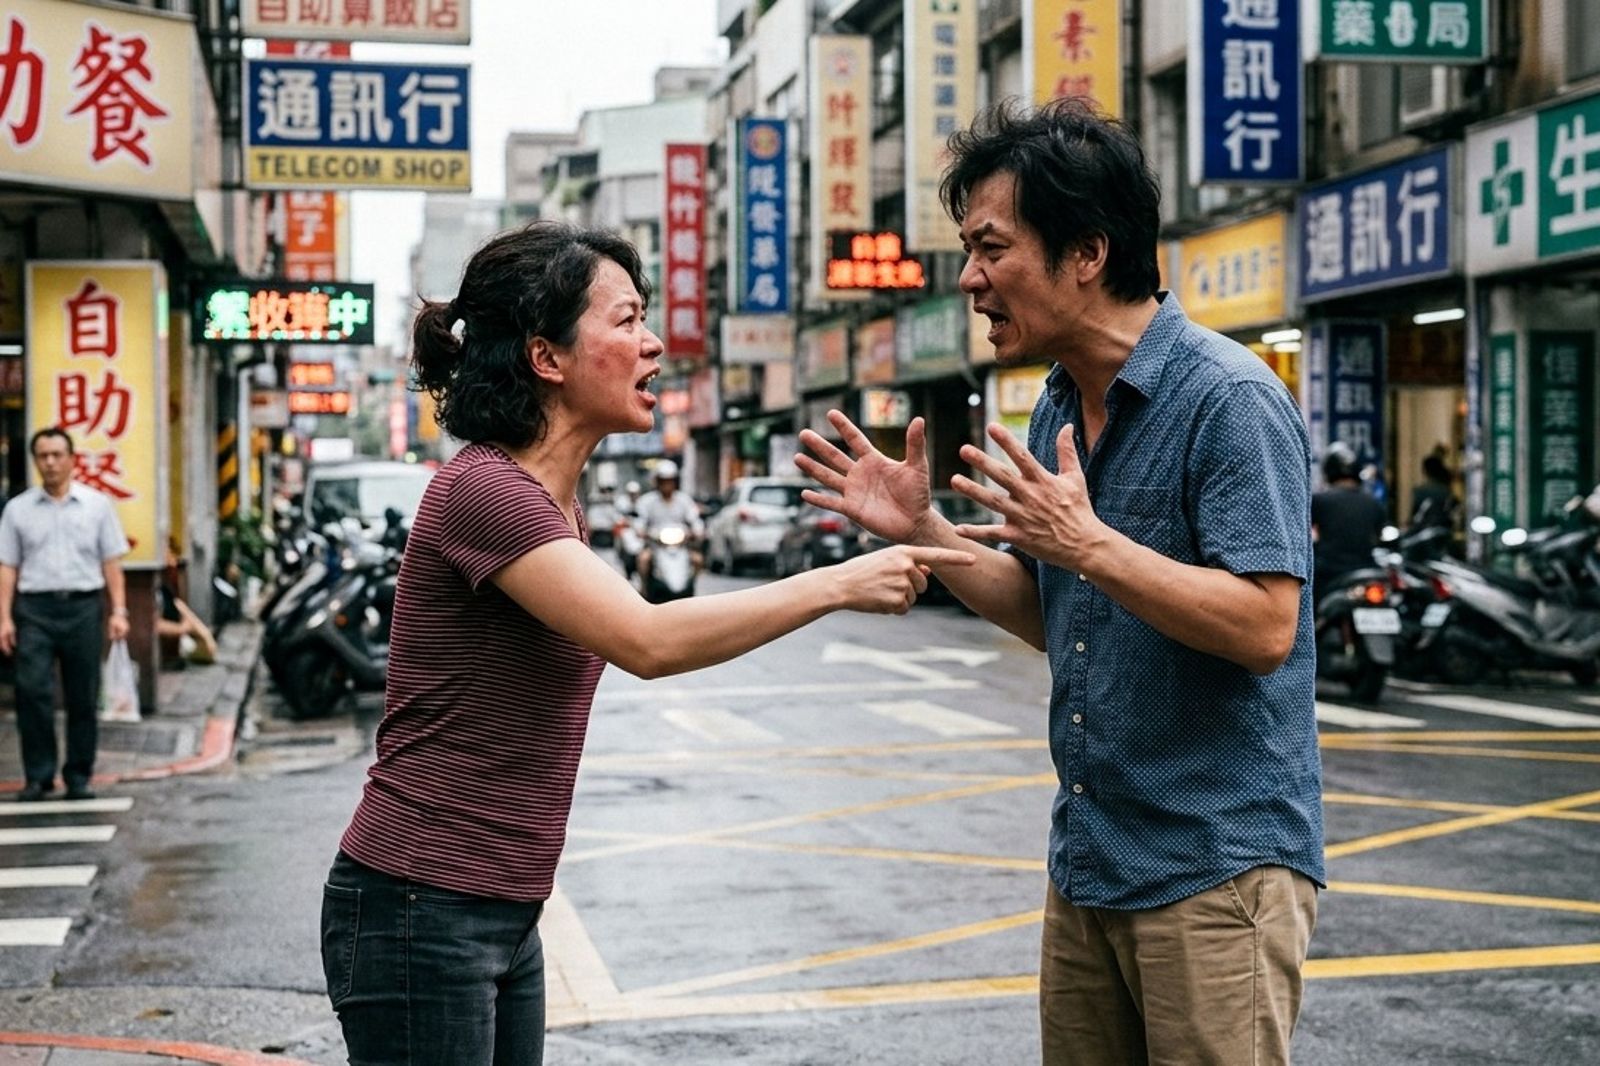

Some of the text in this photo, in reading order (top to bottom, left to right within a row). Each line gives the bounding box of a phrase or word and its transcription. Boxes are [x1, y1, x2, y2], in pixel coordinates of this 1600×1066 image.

[257, 68, 463, 144] 通訊行
[257, 154, 465, 180] TELECOM SHOP
[1549, 113, 1600, 236] 生
[1305, 166, 1441, 286] 通訊行
